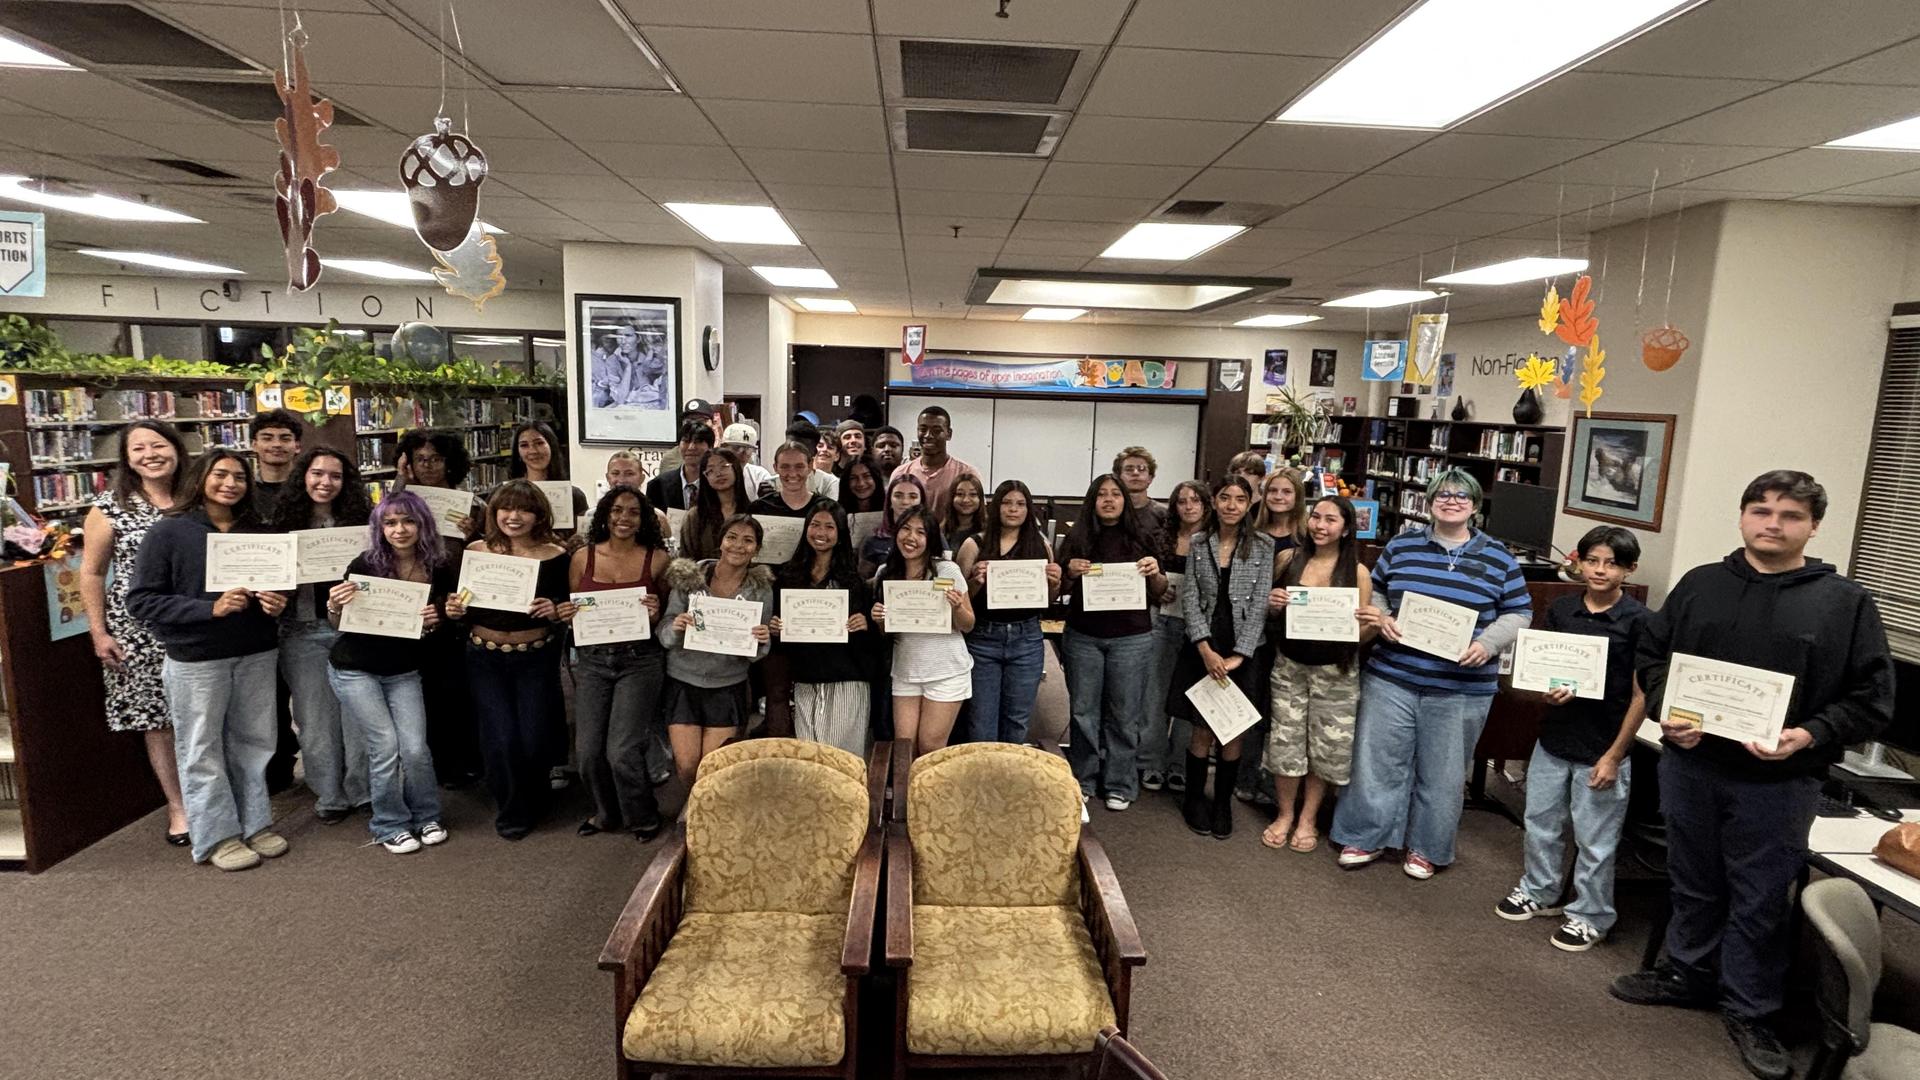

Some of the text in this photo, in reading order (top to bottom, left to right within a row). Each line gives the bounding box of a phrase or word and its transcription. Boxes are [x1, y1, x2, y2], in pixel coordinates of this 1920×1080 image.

[101, 284, 432, 319] FICTION
[223, 543, 282, 556] CERTIFICATE
[475, 563, 525, 578] CERTIFICATE
[792, 598, 837, 609] CERTIFICATE
[1412, 606, 1461, 626] CERTIFICATE
[1531, 643, 1591, 658] CERTIFICATE
[1688, 674, 1767, 698] CERTIFICATE
